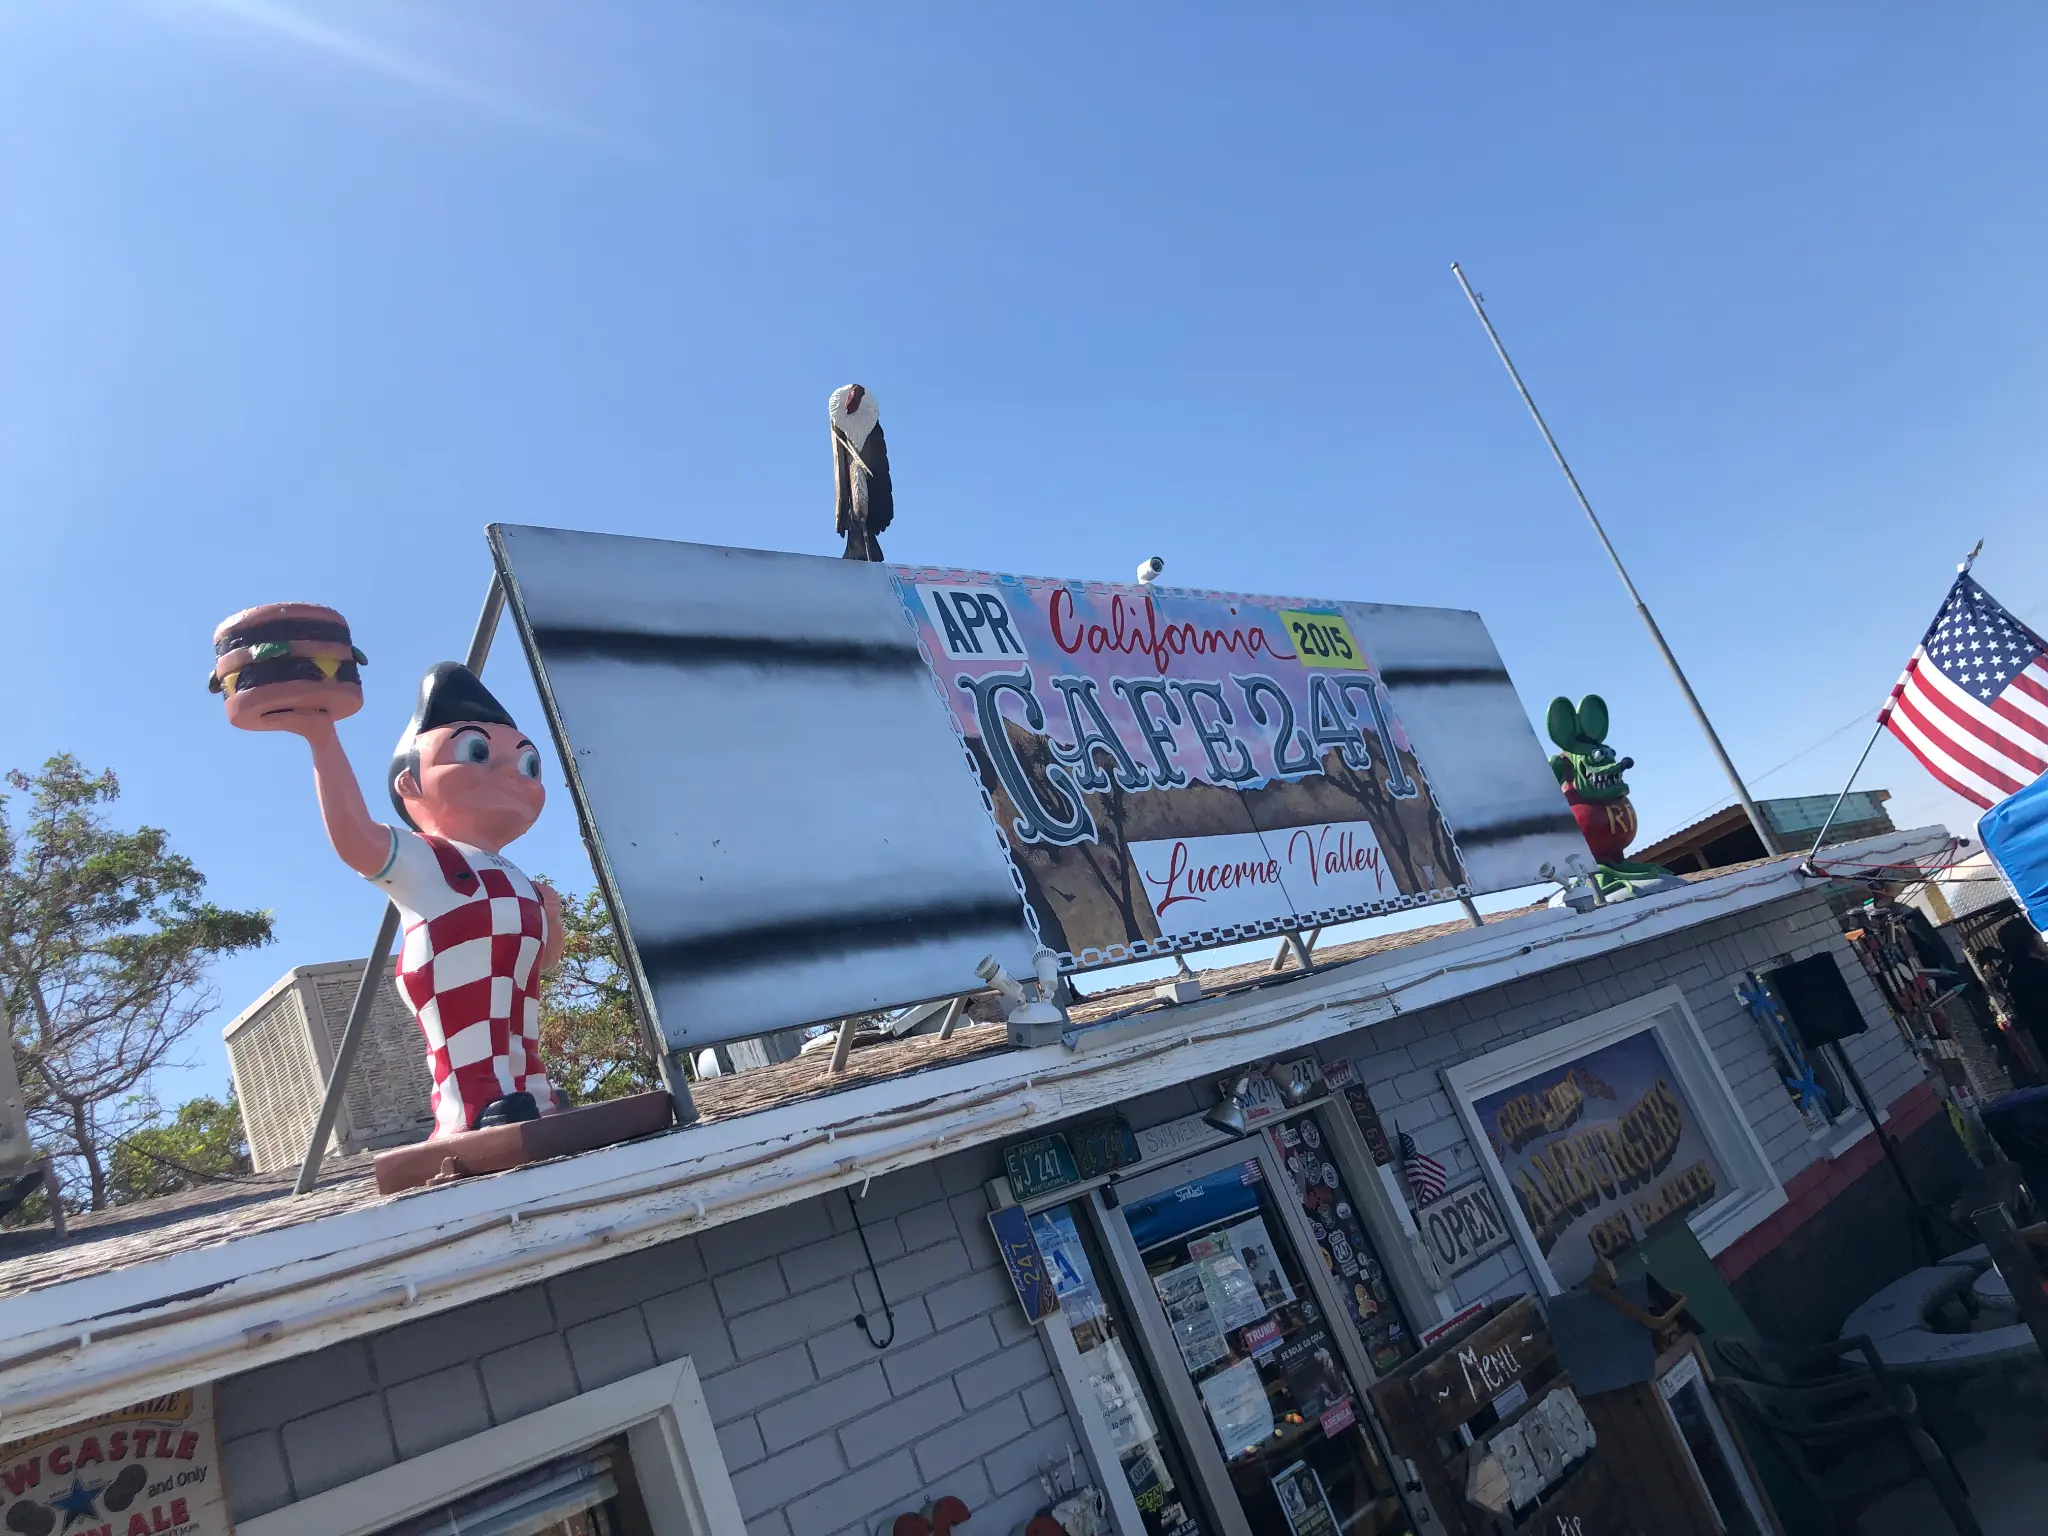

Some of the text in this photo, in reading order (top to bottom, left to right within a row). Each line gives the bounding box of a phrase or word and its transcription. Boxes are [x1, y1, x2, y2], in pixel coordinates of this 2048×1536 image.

[932, 588, 1354, 675] APR California 2015
[1146, 824, 1386, 918] Lucerne Valley
[1035, 1149, 1063, 1181] 247
[1428, 1187, 1503, 1265] OPEN
[1010, 1243, 1041, 1285] 247
[1052, 1249, 1082, 1292] A
[1246, 1321, 1276, 1343] TRUMP
[1457, 1344, 1521, 1403] Menu
[1324, 1408, 1352, 1430] AMERICA
[148, 1465, 208, 1498] and Only
[127, 1497, 190, 1536] ALE
